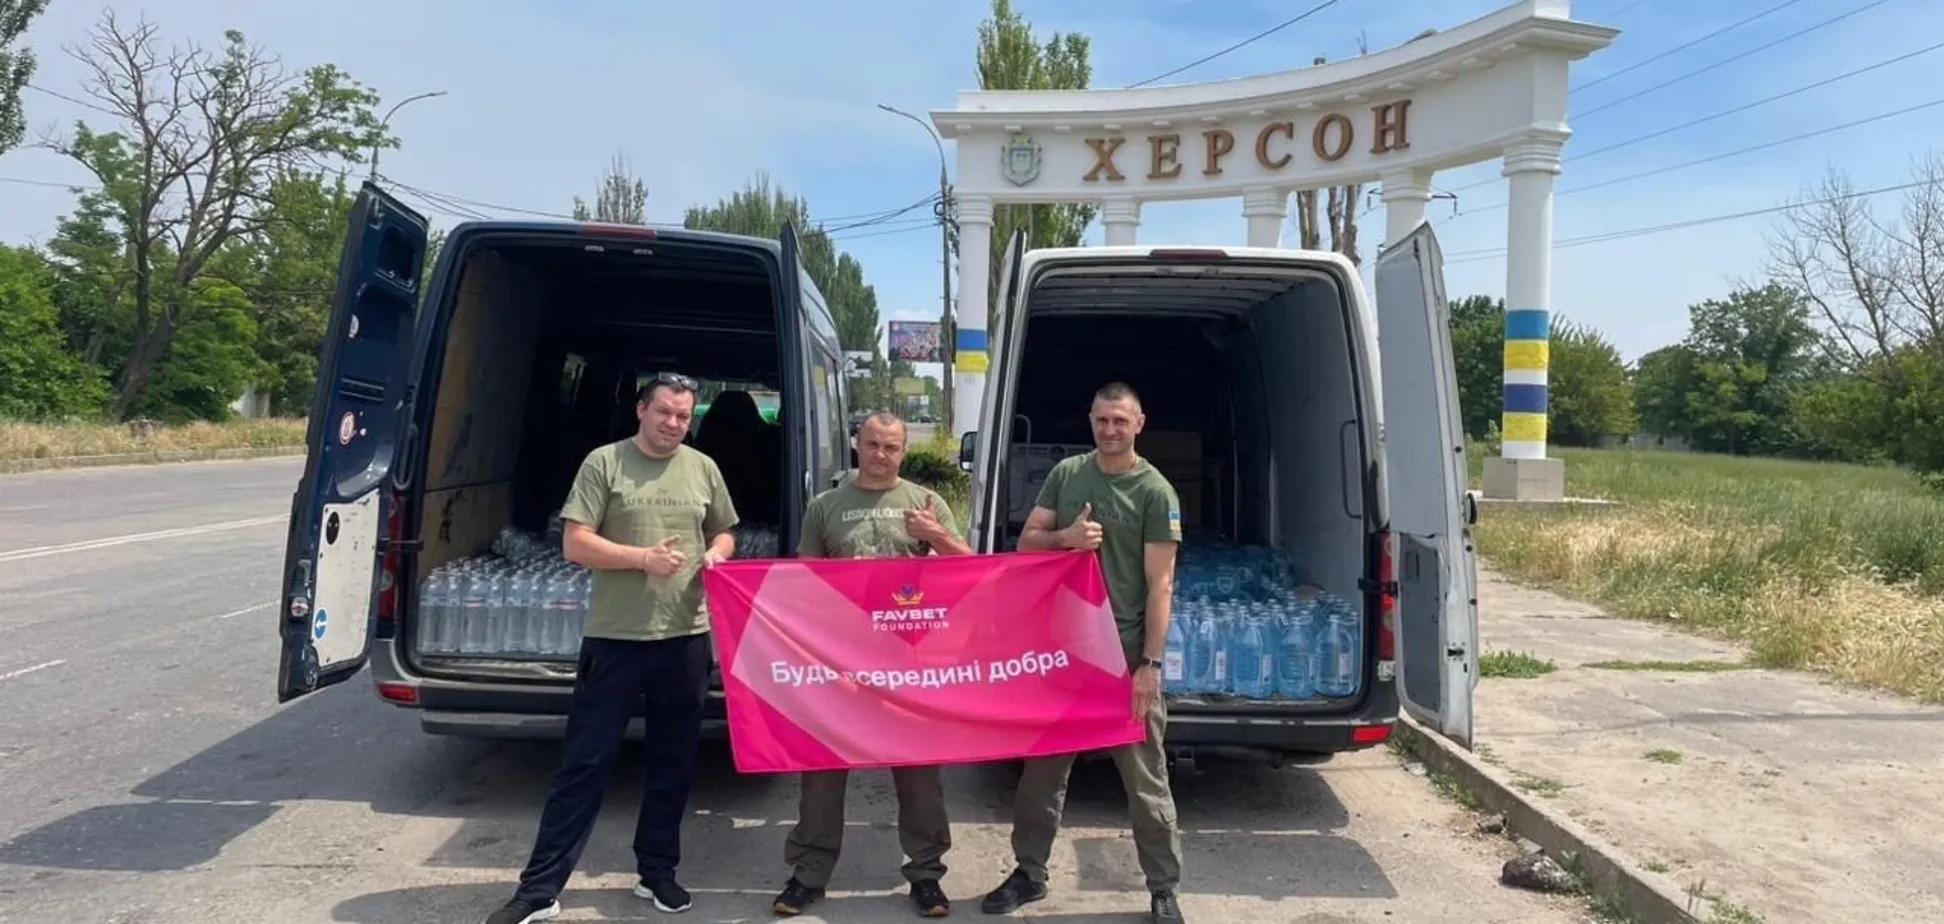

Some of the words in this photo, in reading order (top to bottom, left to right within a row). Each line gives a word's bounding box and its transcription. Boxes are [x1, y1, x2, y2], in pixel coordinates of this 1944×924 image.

[1083, 100, 1412, 182] ХЕРСОН
[871, 607, 948, 621] FAVBET
[872, 620, 949, 632] FOUNDATION
[770, 660, 839, 687] Будь
[989, 649, 1069, 683] добра
